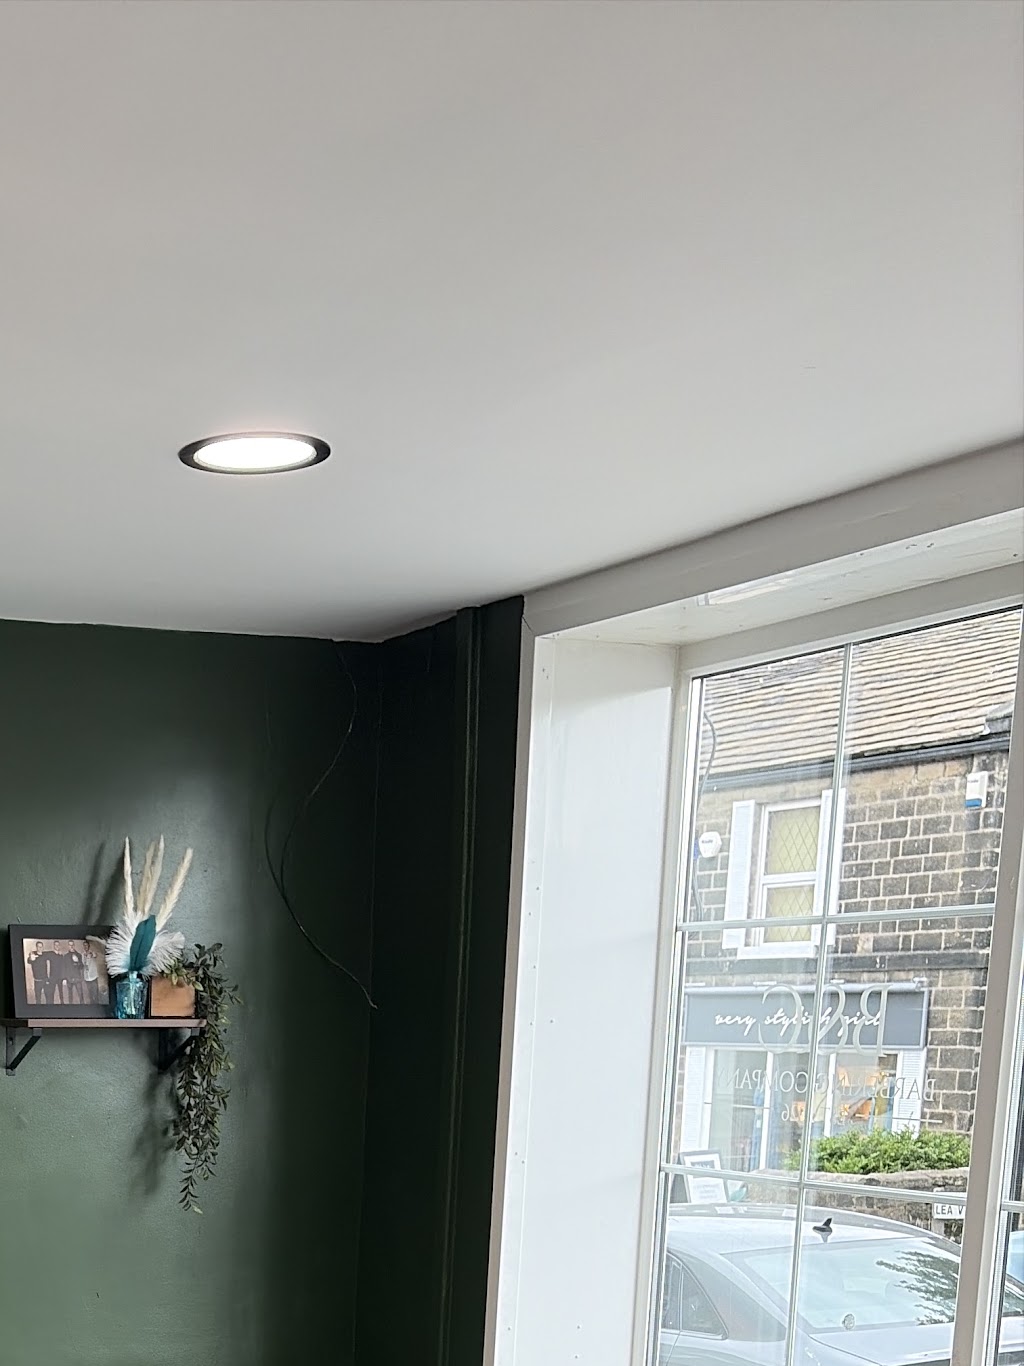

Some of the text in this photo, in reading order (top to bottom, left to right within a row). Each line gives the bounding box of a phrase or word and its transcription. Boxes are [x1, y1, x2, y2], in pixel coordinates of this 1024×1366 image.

[715, 1013, 756, 1036] very
[764, 1007, 832, 1036] stylih
[936, 1205, 952, 1215] LEA
